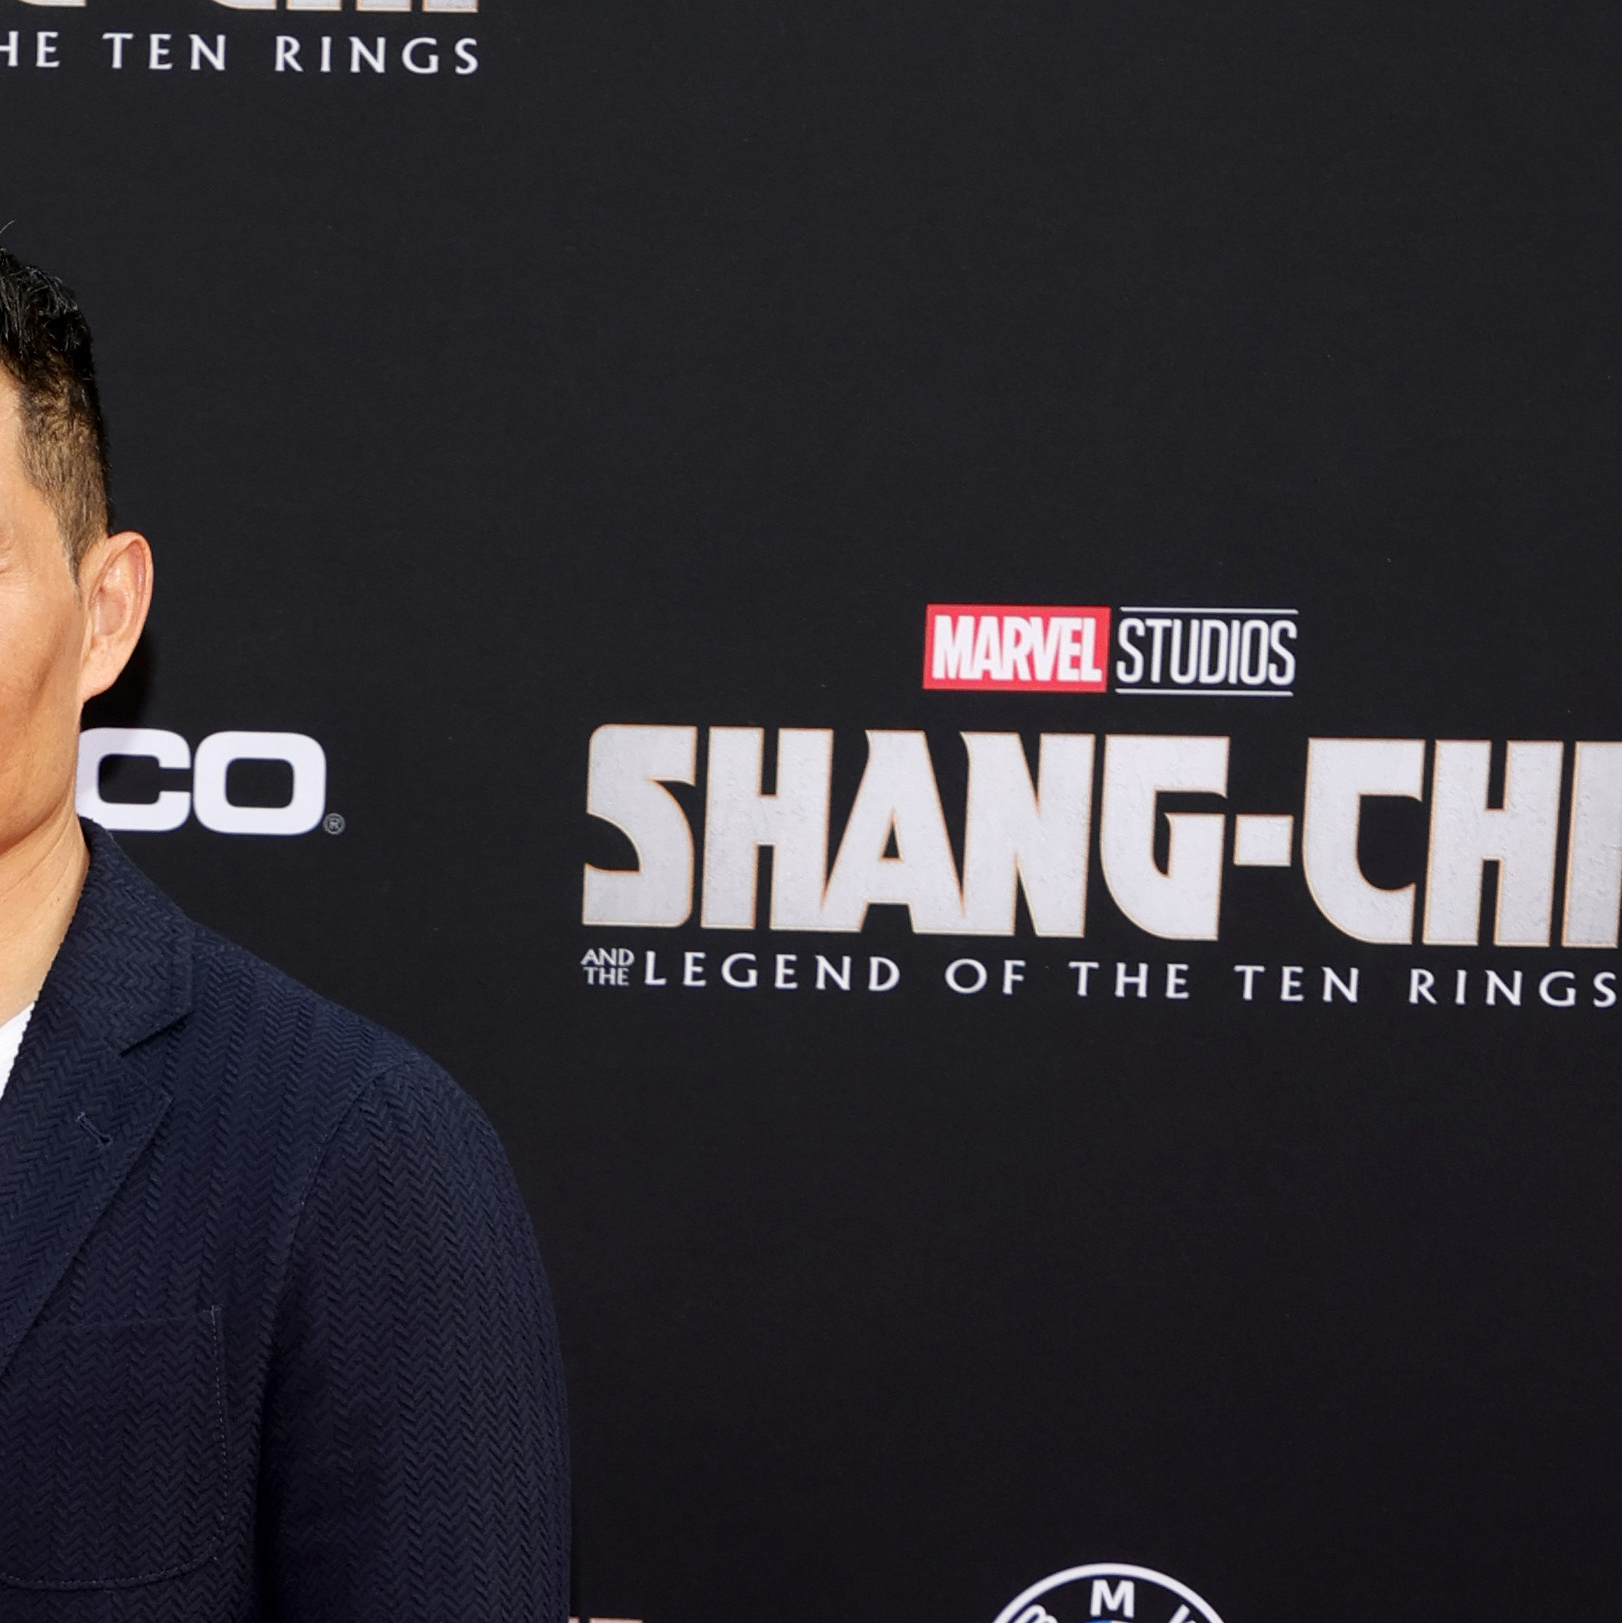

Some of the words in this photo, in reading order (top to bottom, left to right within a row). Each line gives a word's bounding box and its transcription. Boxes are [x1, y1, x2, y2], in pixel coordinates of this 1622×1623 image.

[102, 32, 226, 71] TEN
[274, 35, 480, 75] RINGS
[930, 613, 1104, 684] MARVEL
[1116, 617, 1298, 686] STUDIOS
[582, 724, 1622, 949] SHANG-CHI
[580, 947, 635, 967] AND
[583, 966, 629, 986] THE
[644, 950, 900, 992] LEGEND
[944, 958, 1027, 995] OF
[1068, 961, 1189, 999] THE
[1233, 964, 1359, 1003] TEN
[1408, 968, 1618, 1008] RINGS
